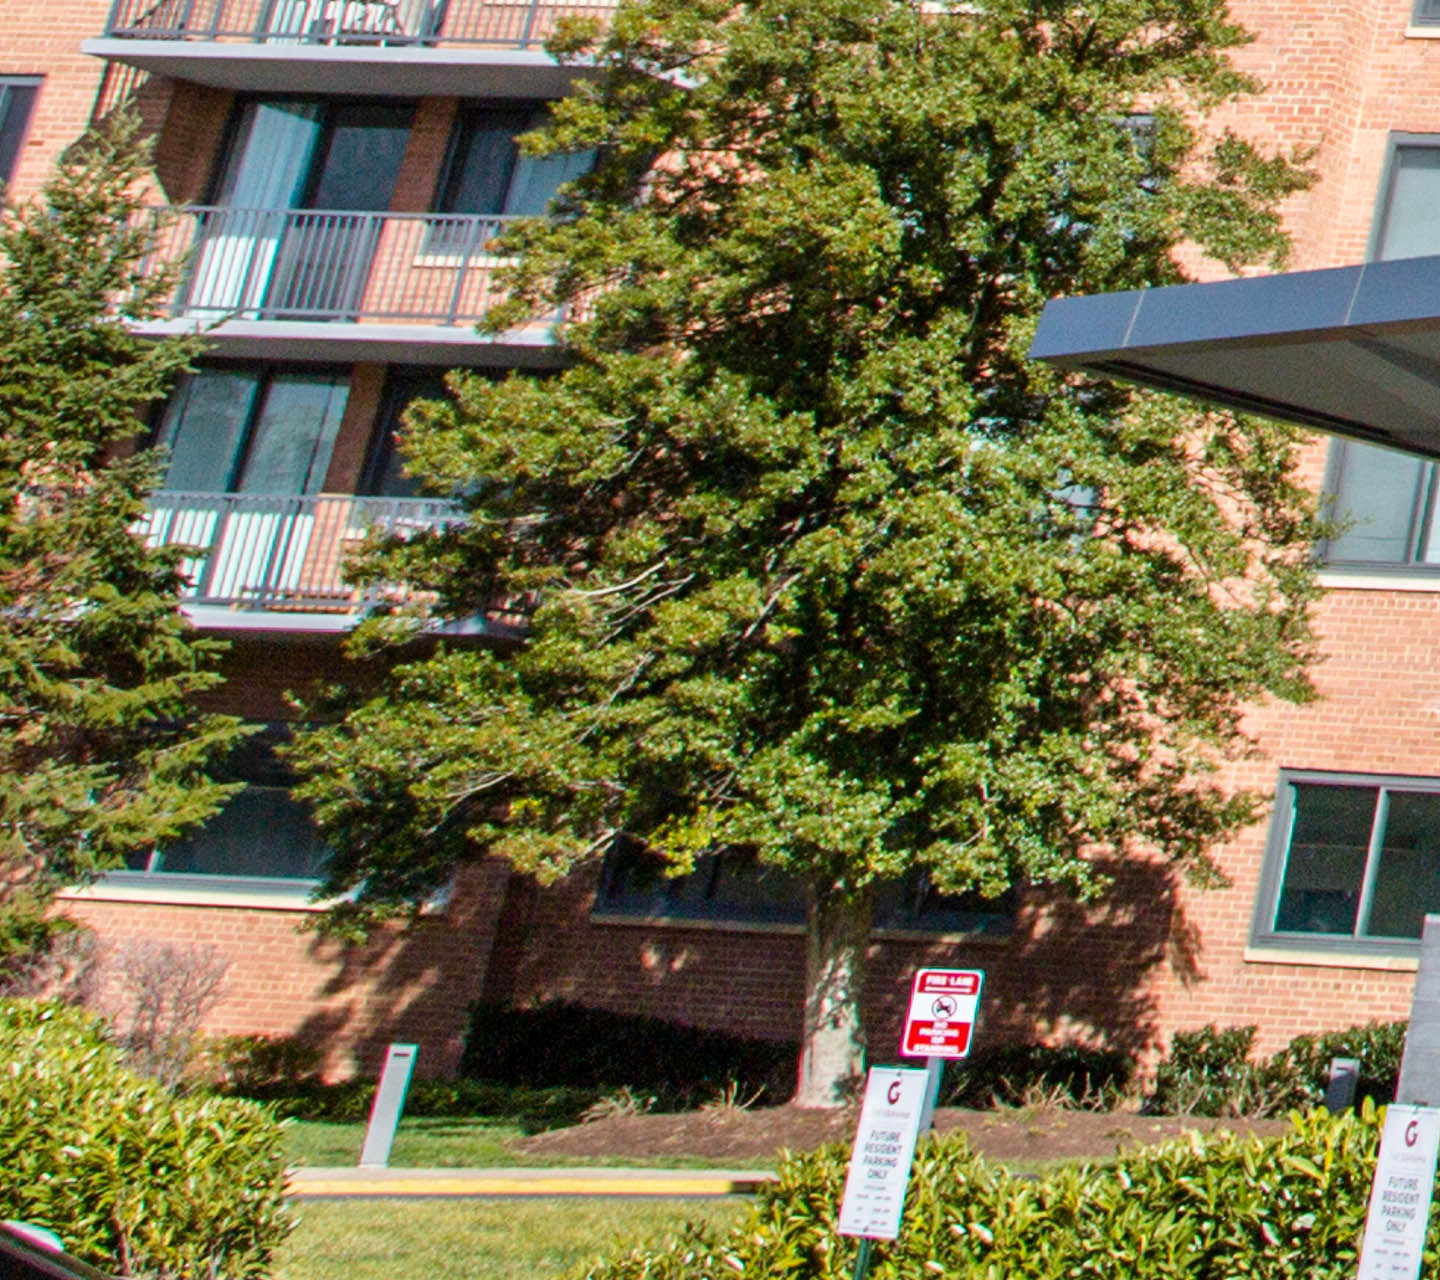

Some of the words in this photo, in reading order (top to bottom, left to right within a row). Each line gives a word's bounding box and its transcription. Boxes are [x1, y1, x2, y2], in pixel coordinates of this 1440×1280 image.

[871, 1129, 900, 1143] FUTURE
[864, 1143, 902, 1156] RESIDENT
[863, 1156, 897, 1168] PARKING
[867, 1168, 888, 1179] ONLY
[1388, 1175, 1418, 1191] FUTURE
[1382, 1190, 1420, 1204] RESIDENT
[1381, 1204, 1416, 1220] PARKING
